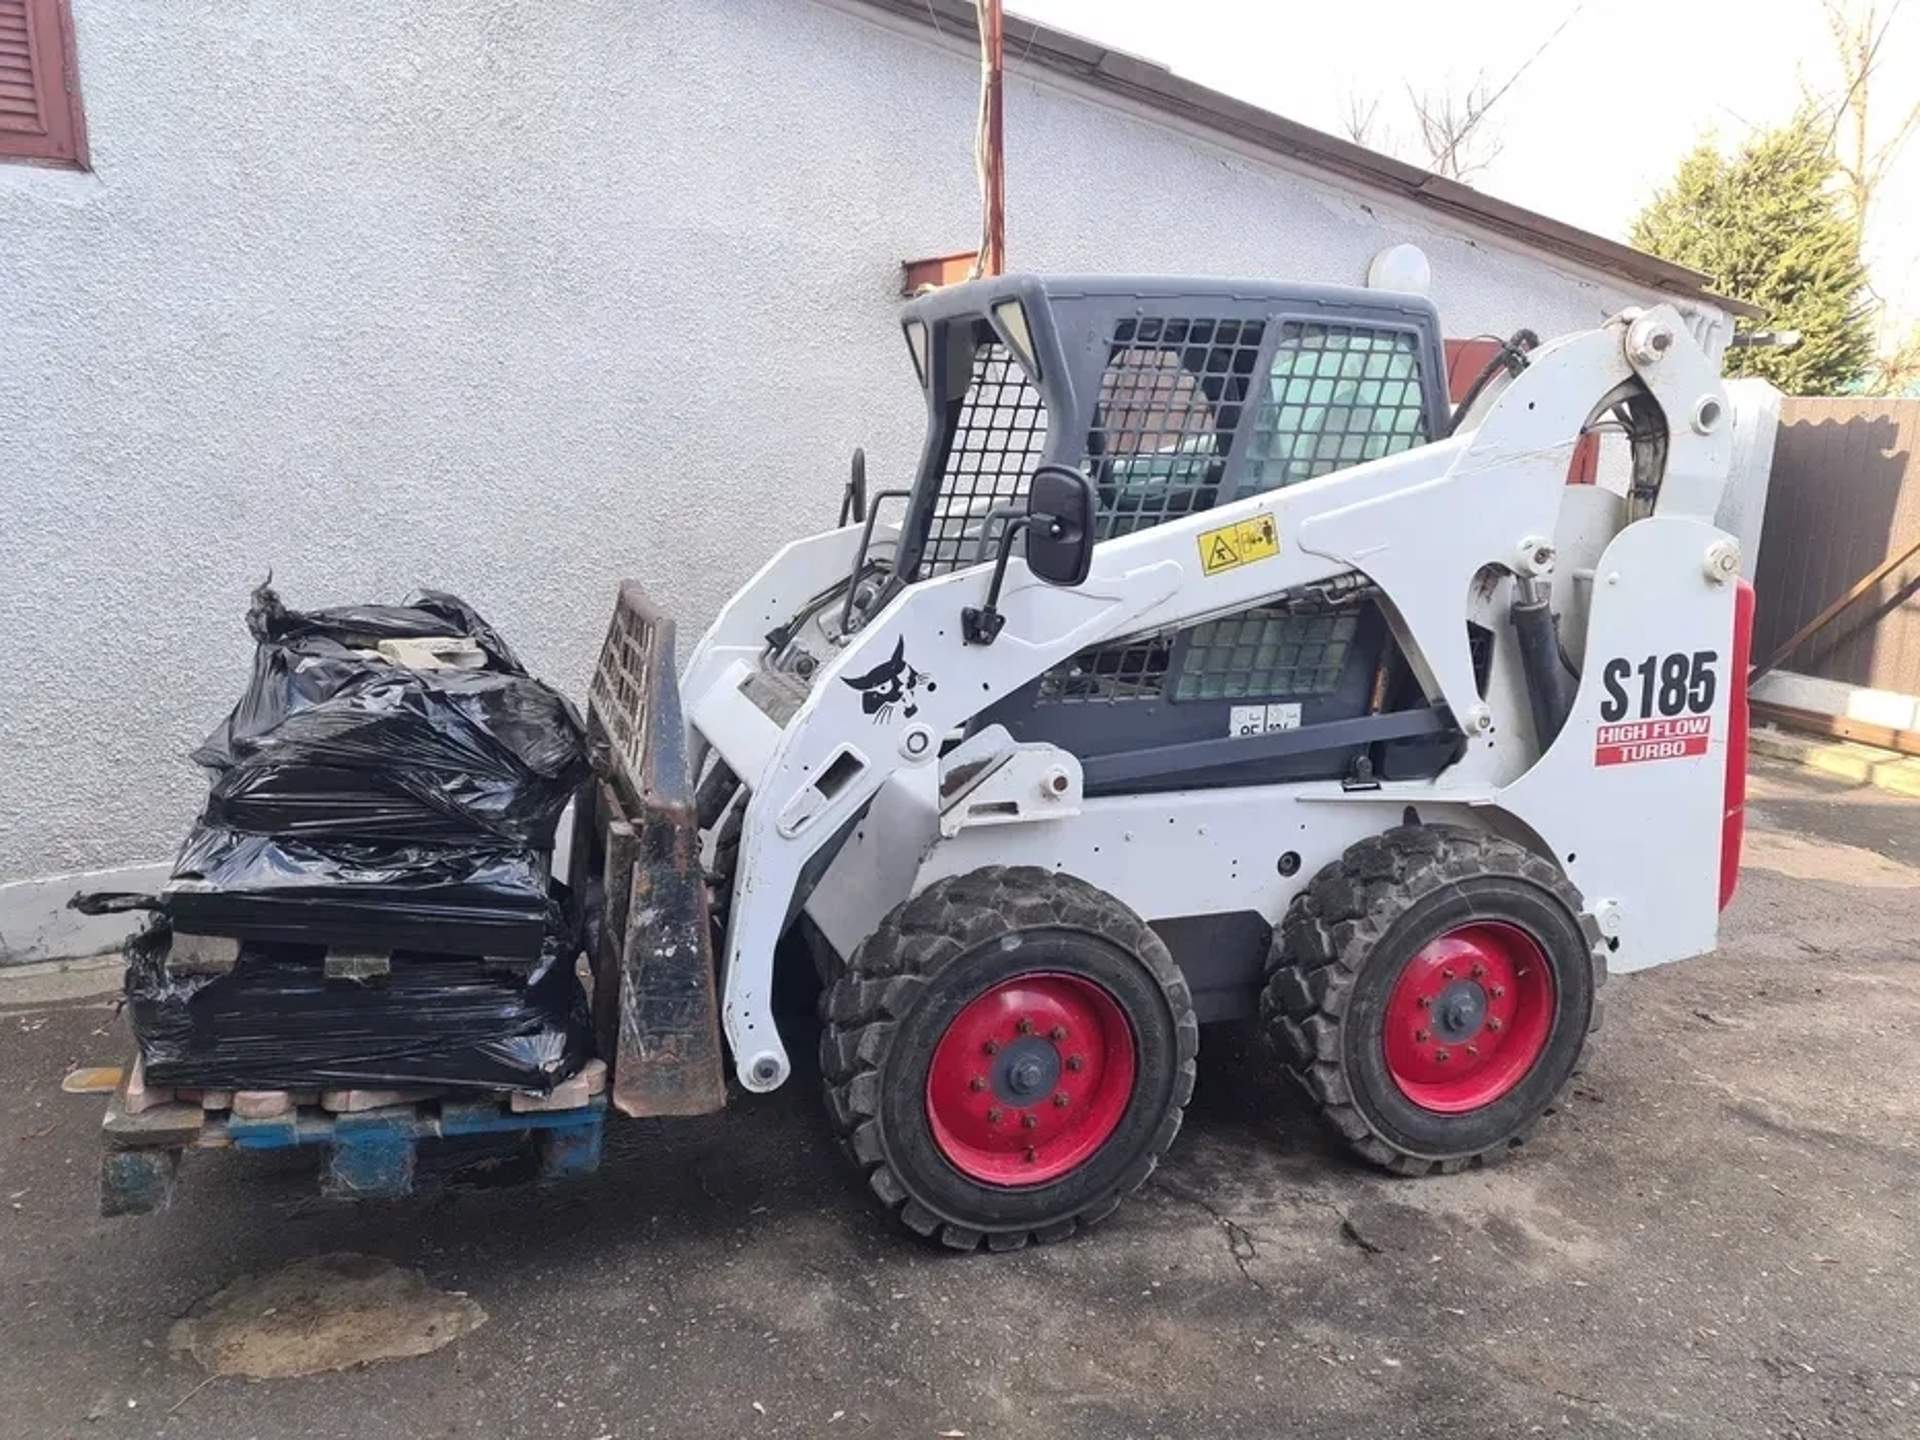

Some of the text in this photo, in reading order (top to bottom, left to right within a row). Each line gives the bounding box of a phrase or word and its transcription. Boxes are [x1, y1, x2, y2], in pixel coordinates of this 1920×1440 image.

[1600, 718, 1707, 743] HIGH FLOW
[1620, 741, 1686, 761] TURBO
